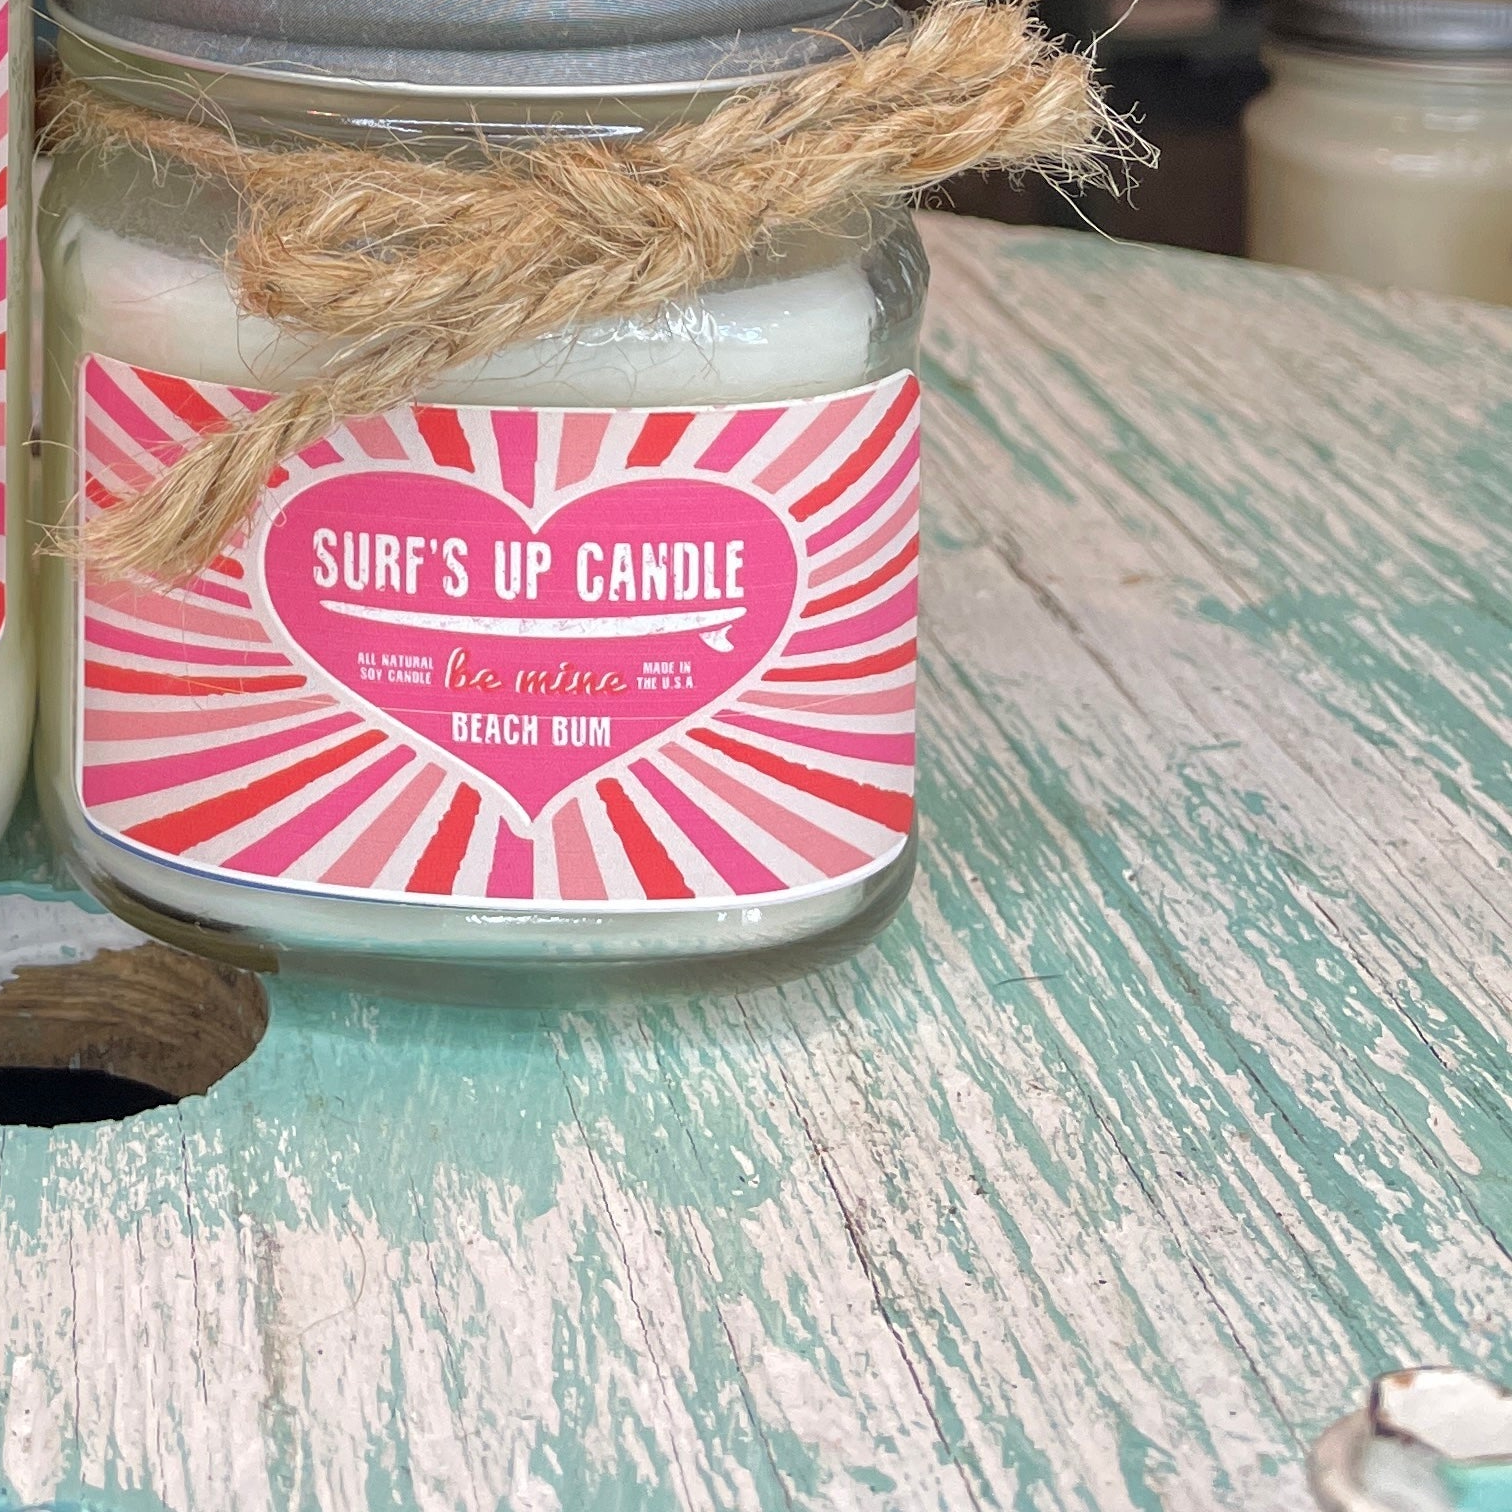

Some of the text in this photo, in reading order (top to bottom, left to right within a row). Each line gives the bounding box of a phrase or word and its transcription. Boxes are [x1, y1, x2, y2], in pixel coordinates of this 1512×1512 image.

[312, 527, 746, 603] SURF'S UP CANDLE
[357, 651, 434, 670] ALL NATURAL
[642, 660, 692, 675] MADE IN
[359, 667, 432, 686] SOY CANDLE
[445, 646, 628, 696] be mine
[636, 676, 658, 691] THE
[451, 713, 611, 747] BEACH BUM
